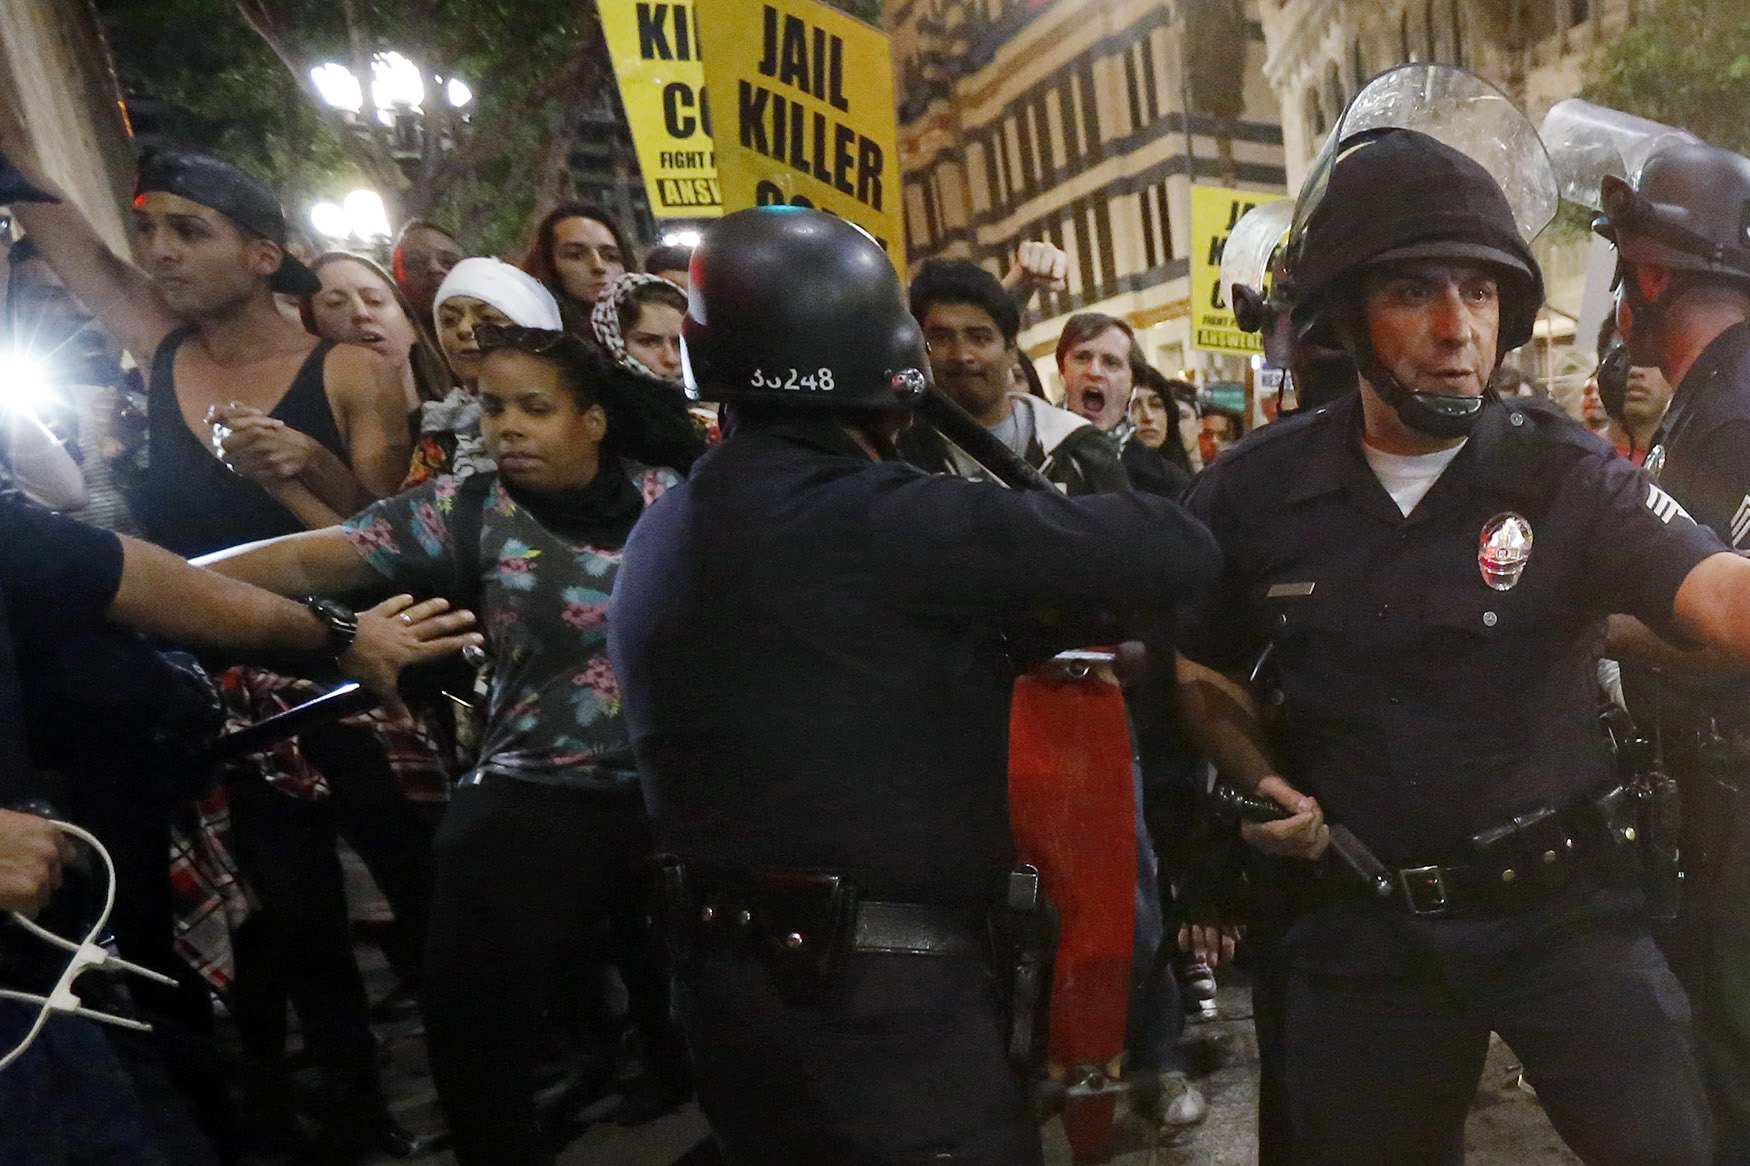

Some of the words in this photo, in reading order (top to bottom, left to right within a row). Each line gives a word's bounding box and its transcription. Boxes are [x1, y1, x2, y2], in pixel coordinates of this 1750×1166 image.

[759, 5, 848, 112] JAIL
[660, 152, 706, 168] FIGHT
[739, 79, 883, 213] KILLER
